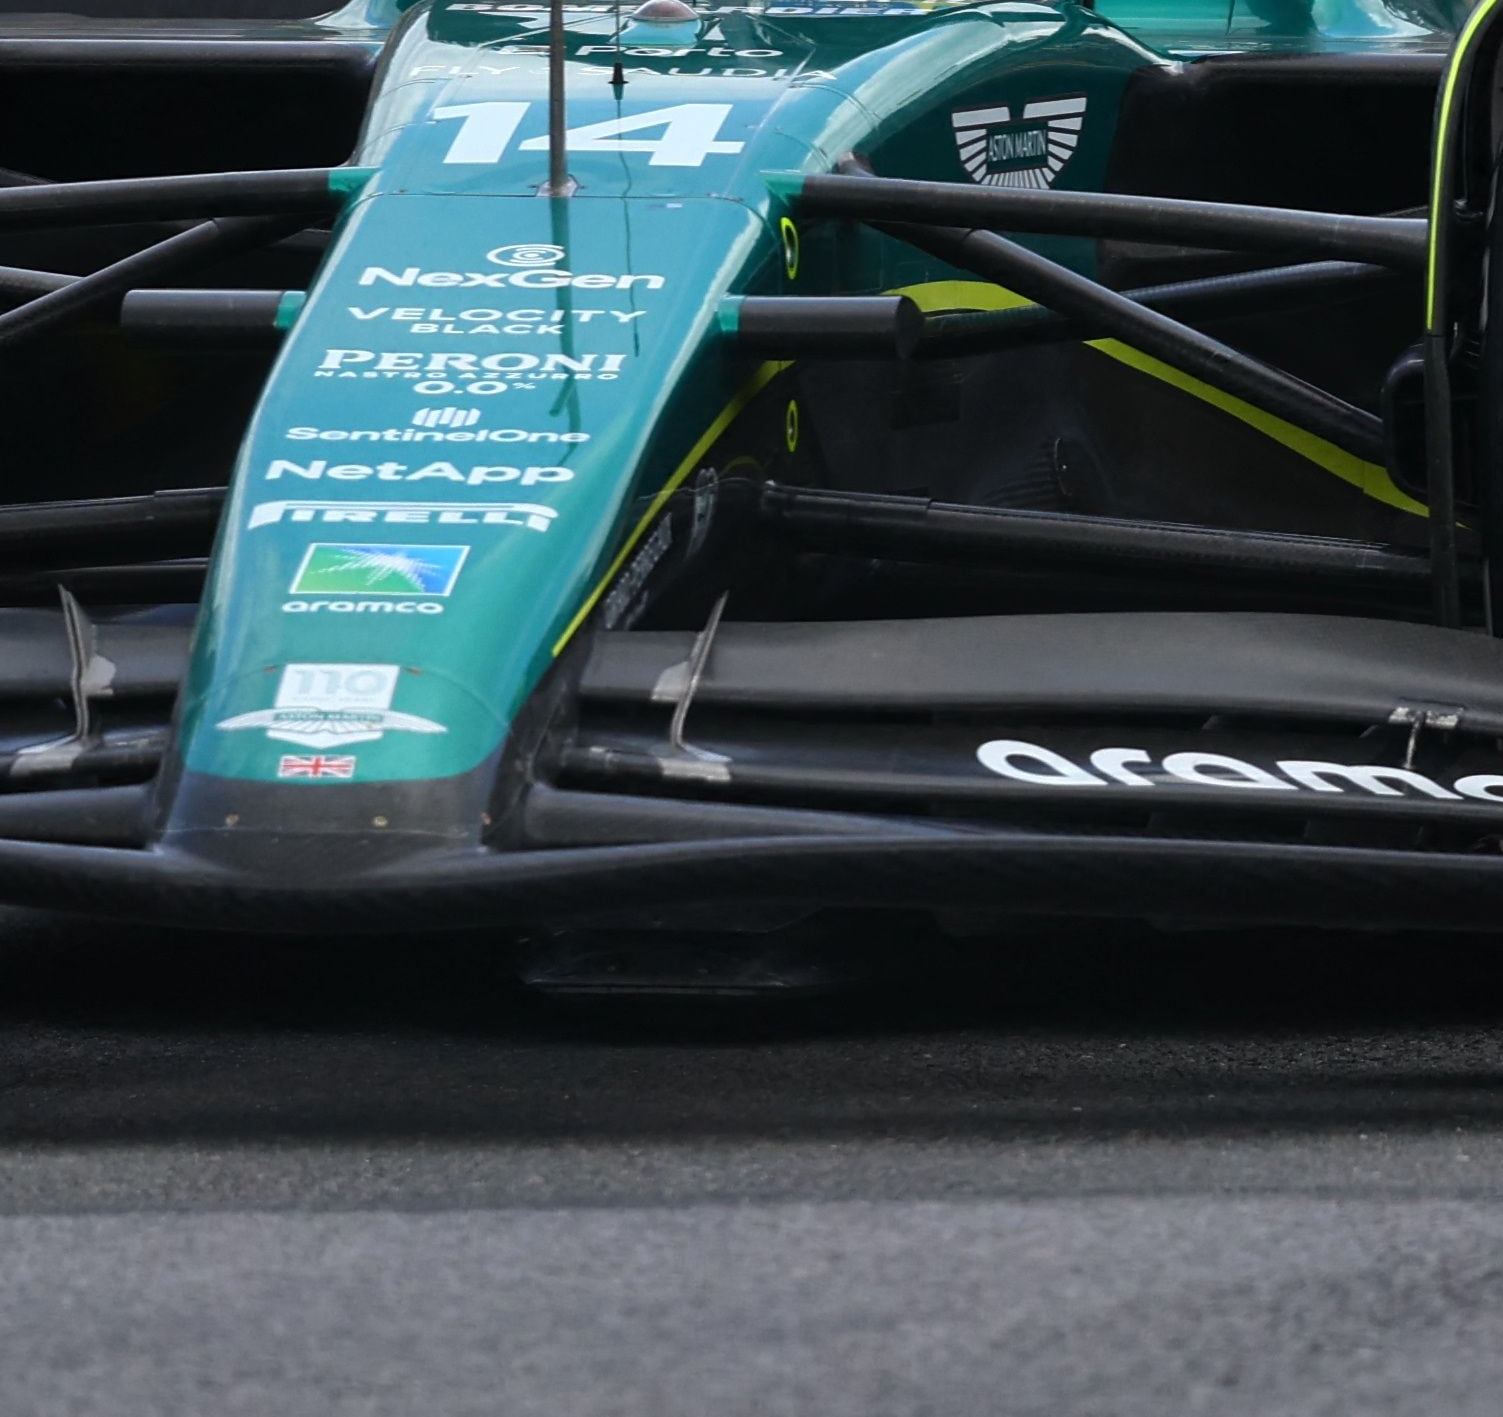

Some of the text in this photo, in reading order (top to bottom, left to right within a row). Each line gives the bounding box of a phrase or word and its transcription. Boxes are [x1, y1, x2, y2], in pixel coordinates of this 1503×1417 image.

[576, 45, 784, 58] Porto
[433, 101, 745, 167] 14
[359, 267, 665, 290] NexGen
[347, 307, 646, 323] VELOCITY
[410, 323, 565, 335] BLACK
[318, 349, 627, 372] PERONI
[314, 371, 619, 381] NASTRO AZZURRO
[286, 427, 591, 443] SentinelOne
[265, 459, 575, 485] NetApp
[248, 500, 559, 533] PIRELLI
[282, 600, 444, 615] aramco
